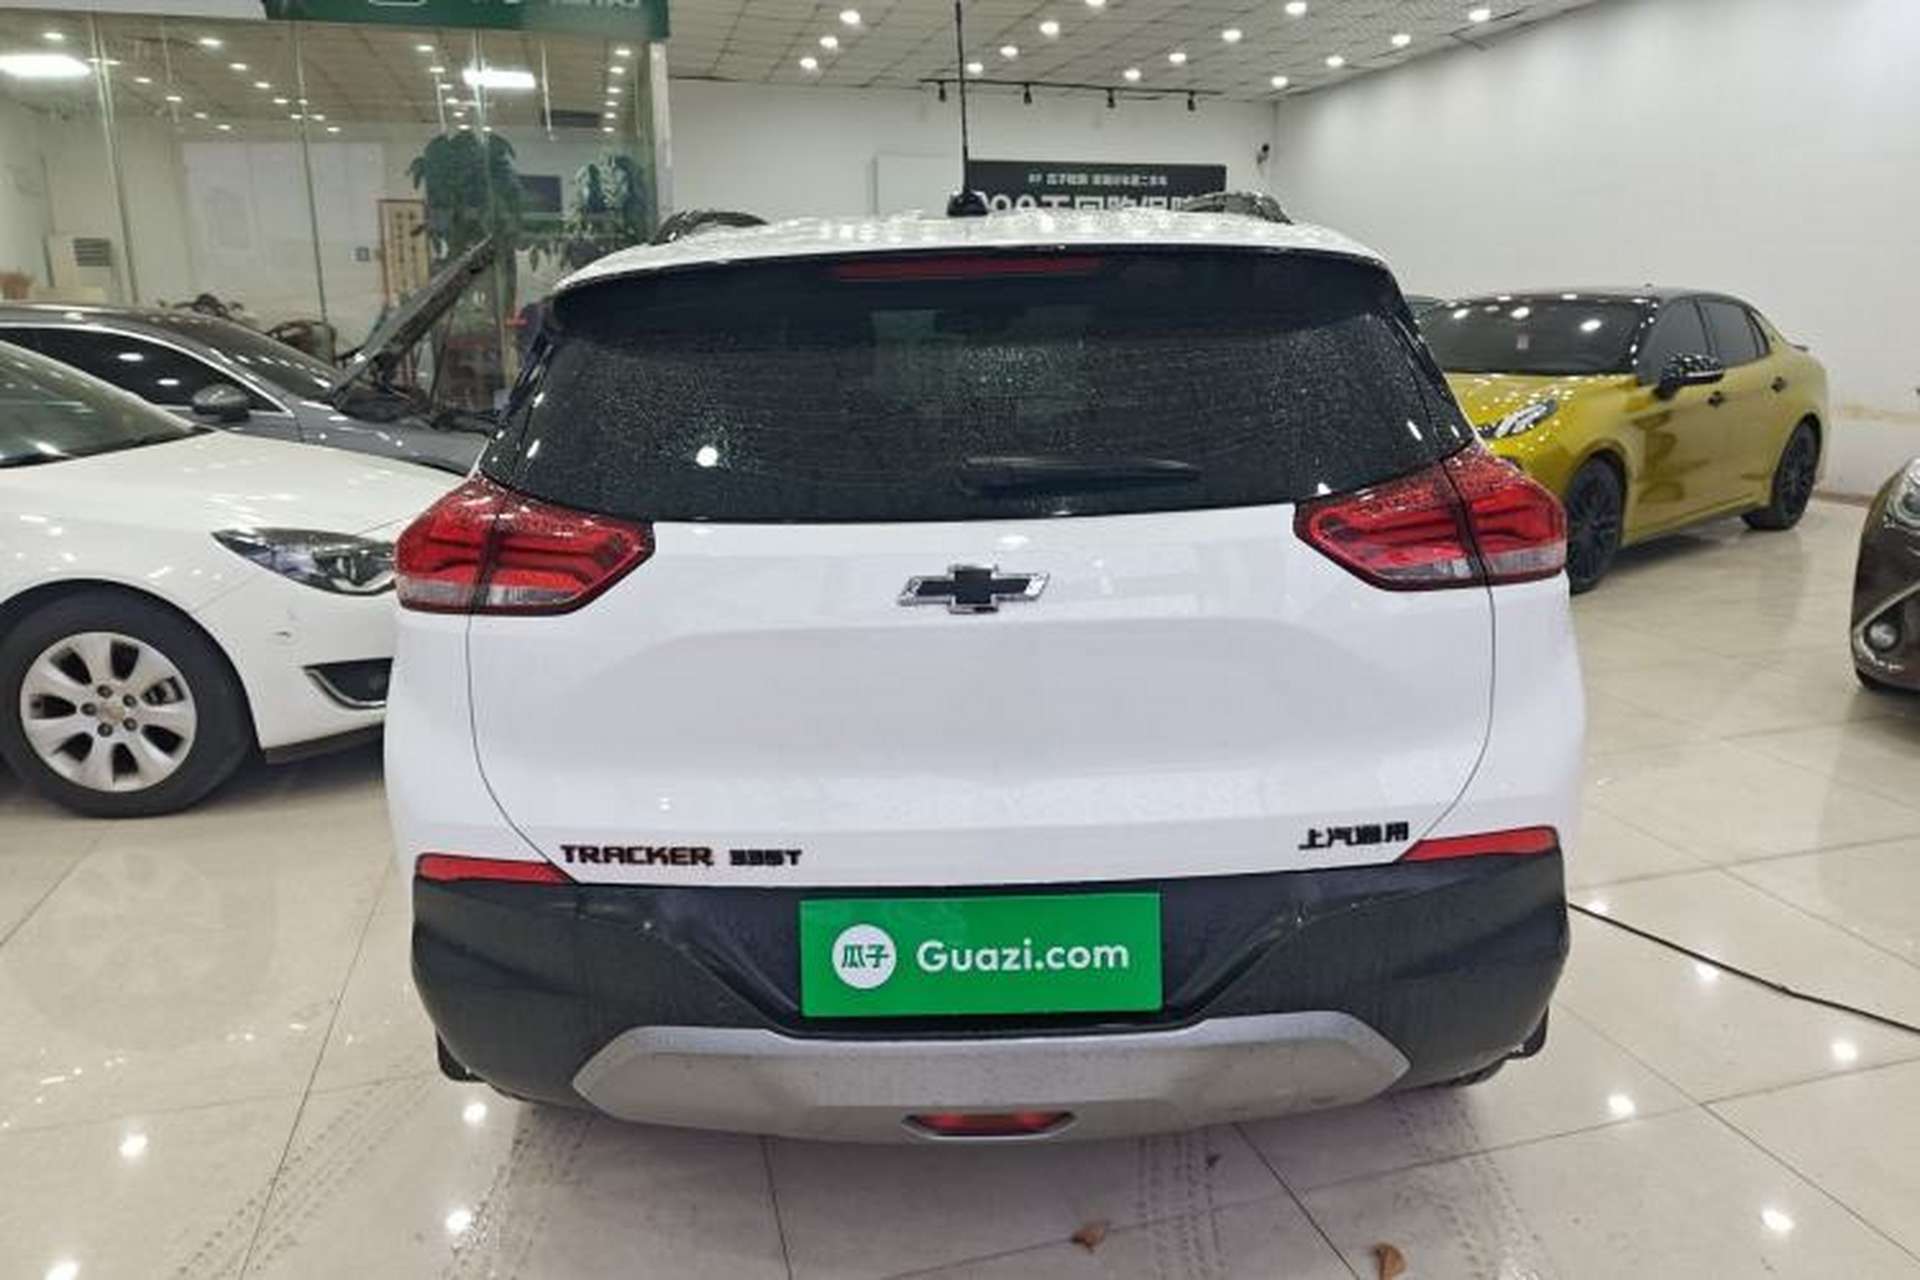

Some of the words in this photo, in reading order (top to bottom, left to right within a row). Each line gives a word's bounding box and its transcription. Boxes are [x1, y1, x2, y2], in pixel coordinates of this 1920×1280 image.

[560, 844, 714, 867] TRACKER
[841, 944, 889, 969] 瓜子
[916, 938, 1129, 973] Guazi.com
